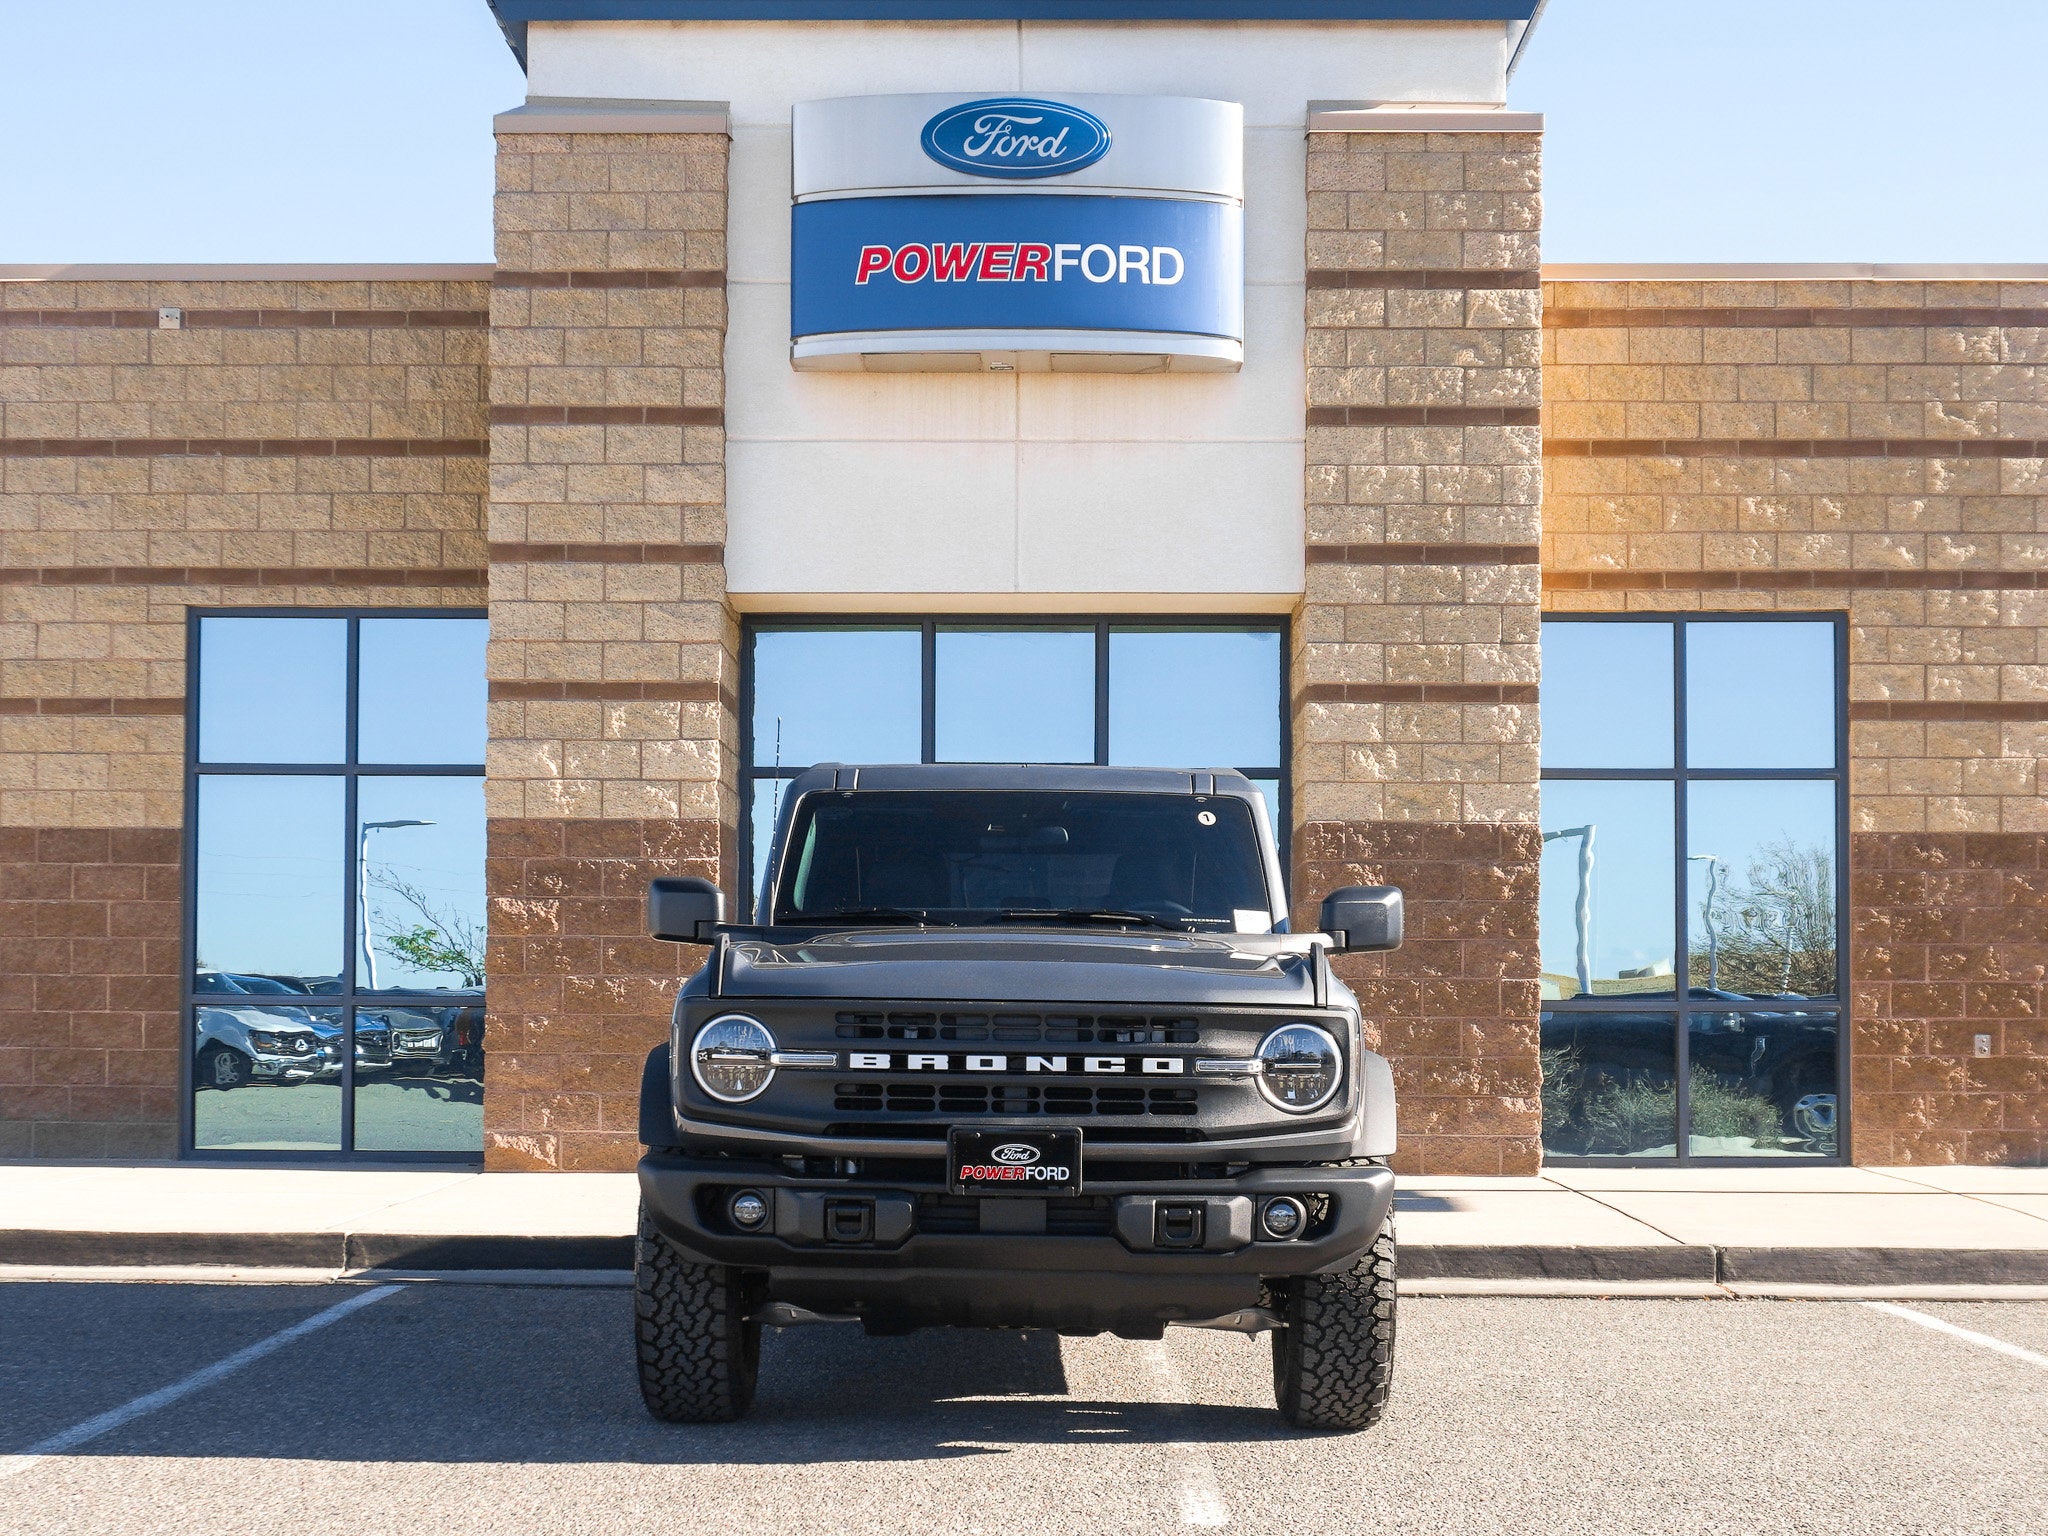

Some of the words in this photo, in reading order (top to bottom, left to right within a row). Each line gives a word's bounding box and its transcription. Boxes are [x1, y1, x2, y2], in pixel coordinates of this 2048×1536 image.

[963, 114, 1070, 158] Ford
[855, 242, 1185, 286] POWERFORD
[850, 1052, 1184, 1074] BRONCO
[1001, 1147, 1030, 1161] Ford
[960, 1165, 1070, 1181] POWERFORD
